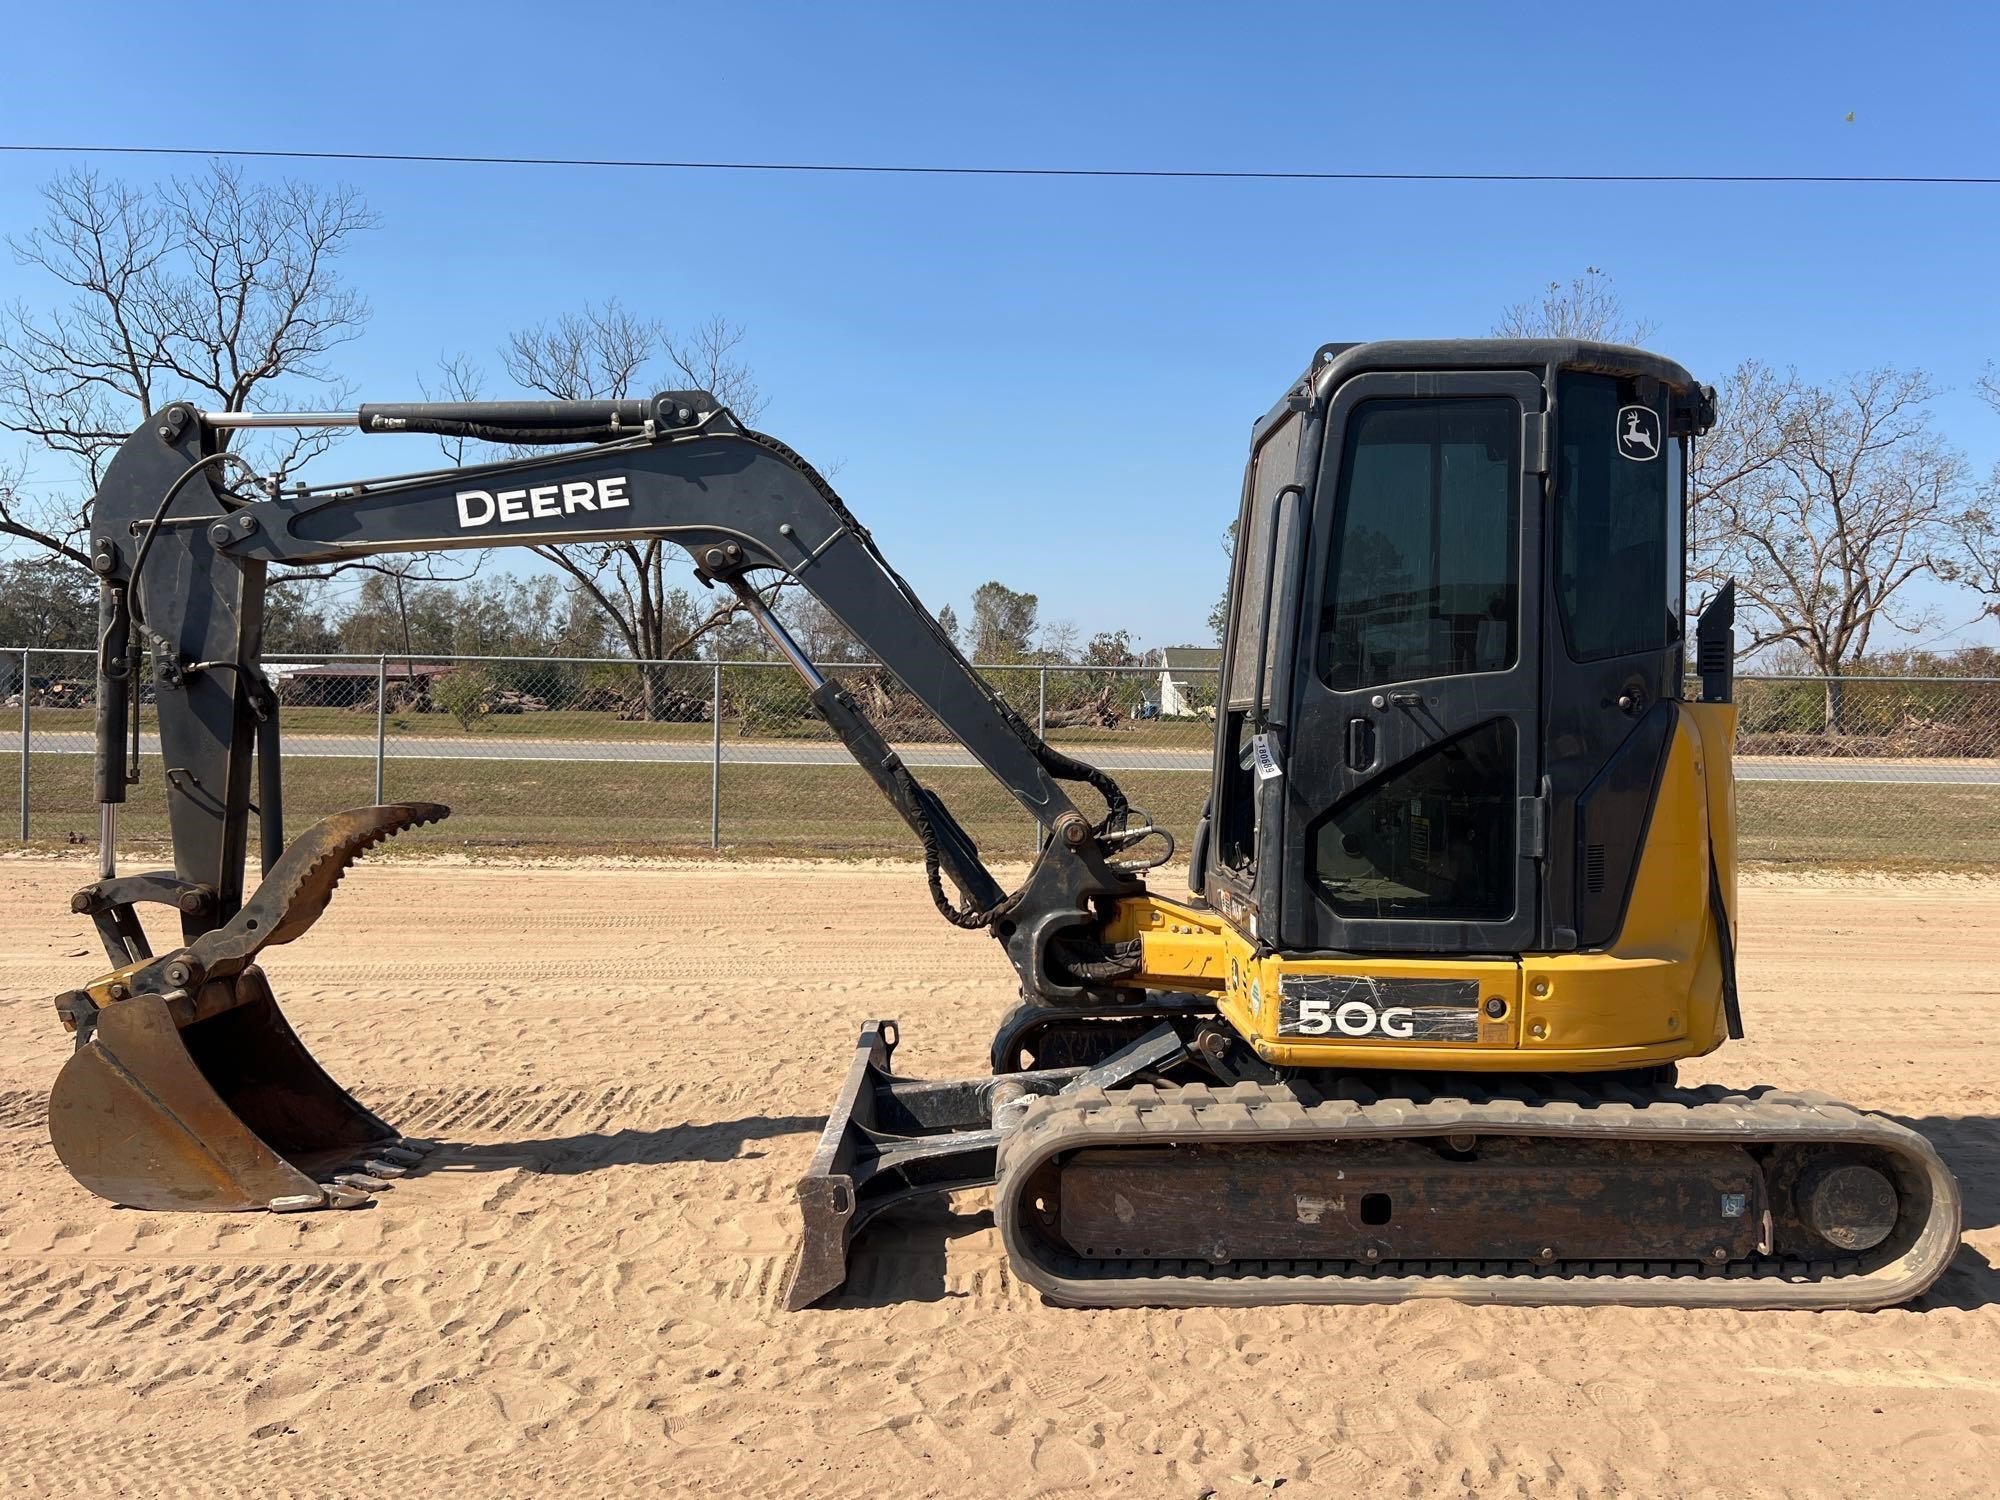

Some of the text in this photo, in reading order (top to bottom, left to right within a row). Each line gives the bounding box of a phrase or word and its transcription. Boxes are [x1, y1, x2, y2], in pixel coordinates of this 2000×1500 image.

[456, 477, 630, 528] DEERE
[1259, 744, 1275, 773] 180689
[1299, 1000, 1414, 1037] 50G
